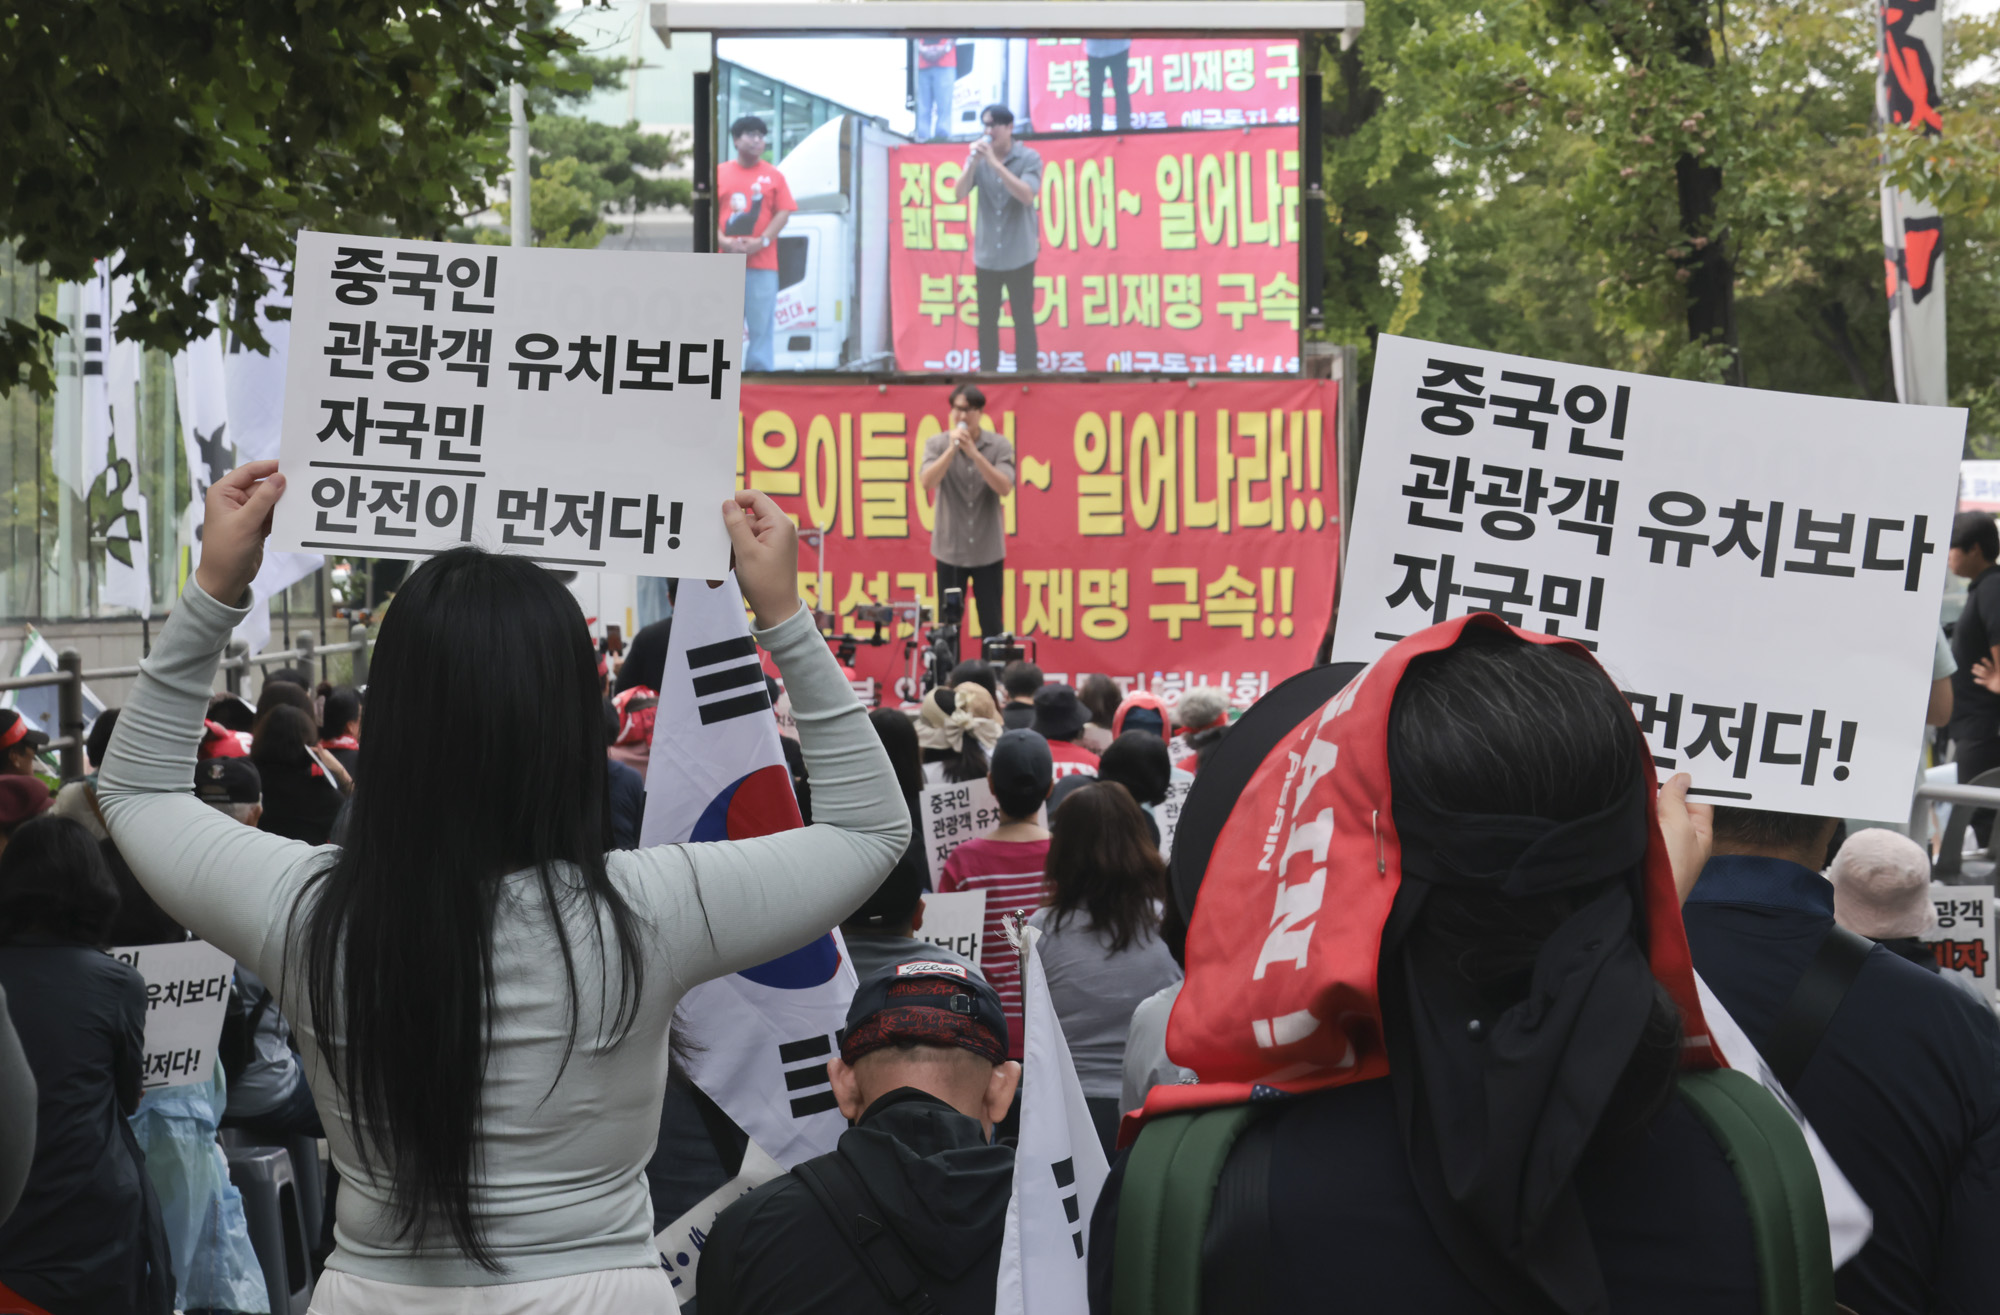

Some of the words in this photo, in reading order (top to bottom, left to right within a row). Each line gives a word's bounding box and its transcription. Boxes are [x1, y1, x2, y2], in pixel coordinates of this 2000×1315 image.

[1162, 47, 1256, 93] 리재명
[330, 246, 498, 314] 중국인
[1082, 273, 1203, 329] 리재명
[323, 320, 493, 388] 관광객
[508, 333, 731, 400] 유치보다
[316, 397, 485, 463] 자국민
[1416, 358, 1632, 462] 중국인
[1073, 408, 1325, 536] 일어나라!!
[311, 475, 477, 543] 안전이
[497, 487, 684, 554] 먼저다!
[1402, 453, 1620, 557] 관광객
[1638, 490, 1935, 592] 유치보다
[1149, 564, 1295, 640] 구속!!
[930, 786, 970, 815] 중국인
[932, 811, 973, 840] 관광객
[905, 962, 963, 976] Titleist
